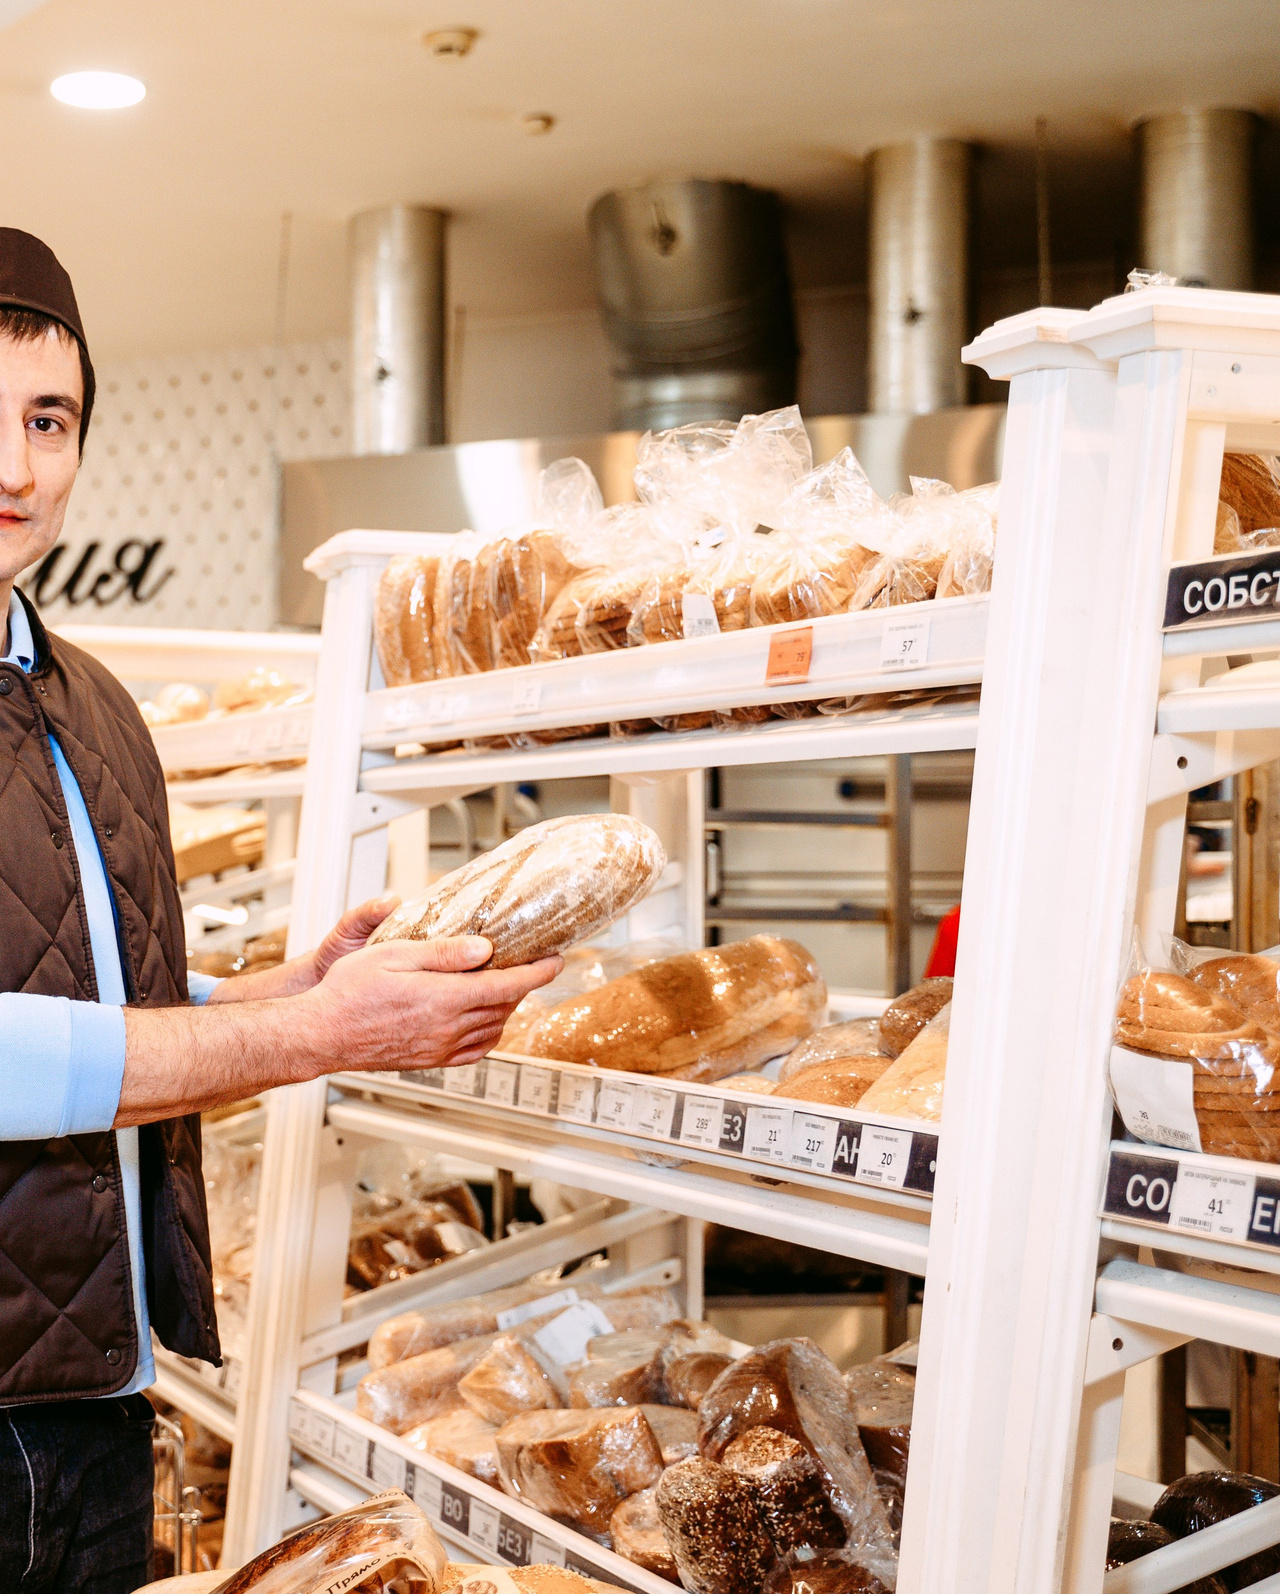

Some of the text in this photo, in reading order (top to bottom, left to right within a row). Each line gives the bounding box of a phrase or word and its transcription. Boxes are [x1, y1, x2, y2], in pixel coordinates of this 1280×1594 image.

[902, 640, 913, 652] 57
[768, 1130, 777, 1142] 21
[806, 1139, 821, 1153] 217
[881, 1152, 893, 1166] 20
[1208, 1198, 1223, 1214] 41
